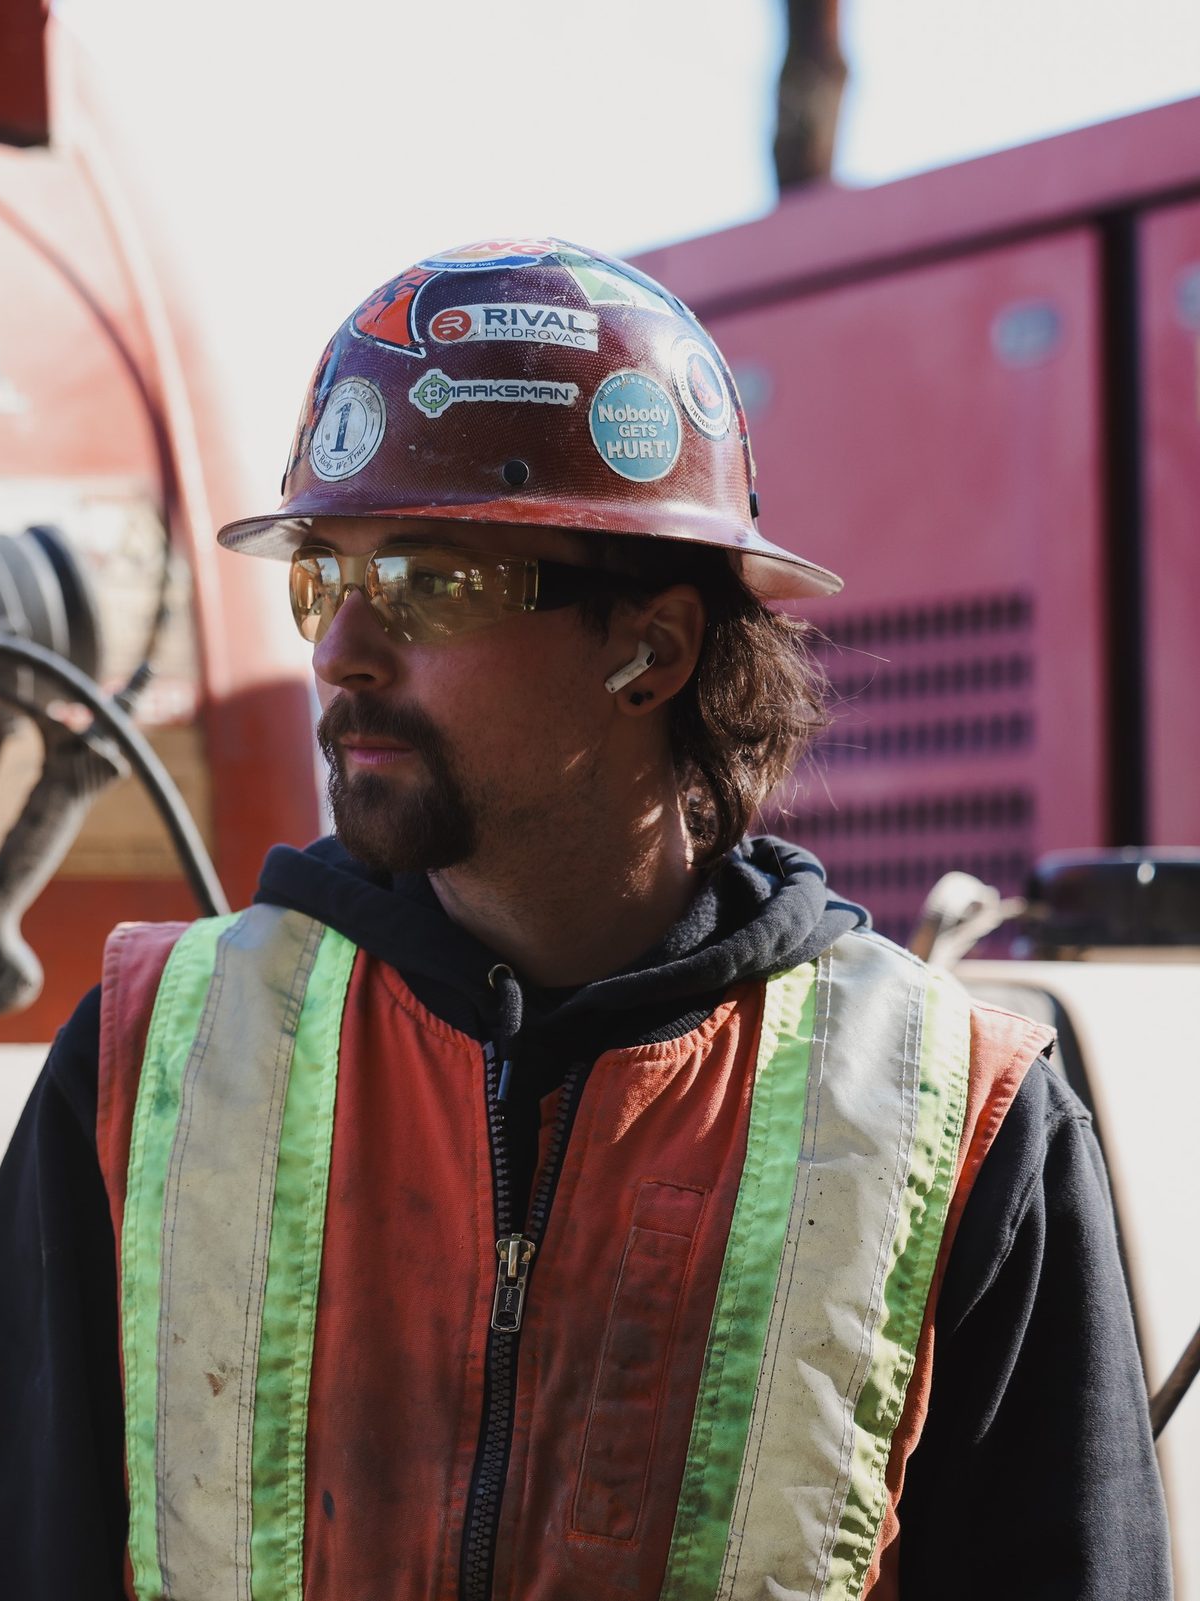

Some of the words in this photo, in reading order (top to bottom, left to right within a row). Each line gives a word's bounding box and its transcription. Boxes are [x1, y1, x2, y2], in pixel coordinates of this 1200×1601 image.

[483, 308, 585, 333] RIVAL
[485, 328, 586, 346] HYDROVAC
[438, 384, 570, 401] MARKSMAN
[597, 403, 670, 427] Nobody
[330, 402, 352, 453] 1
[618, 424, 658, 438] GETS
[606, 440, 673, 460] HURT!
